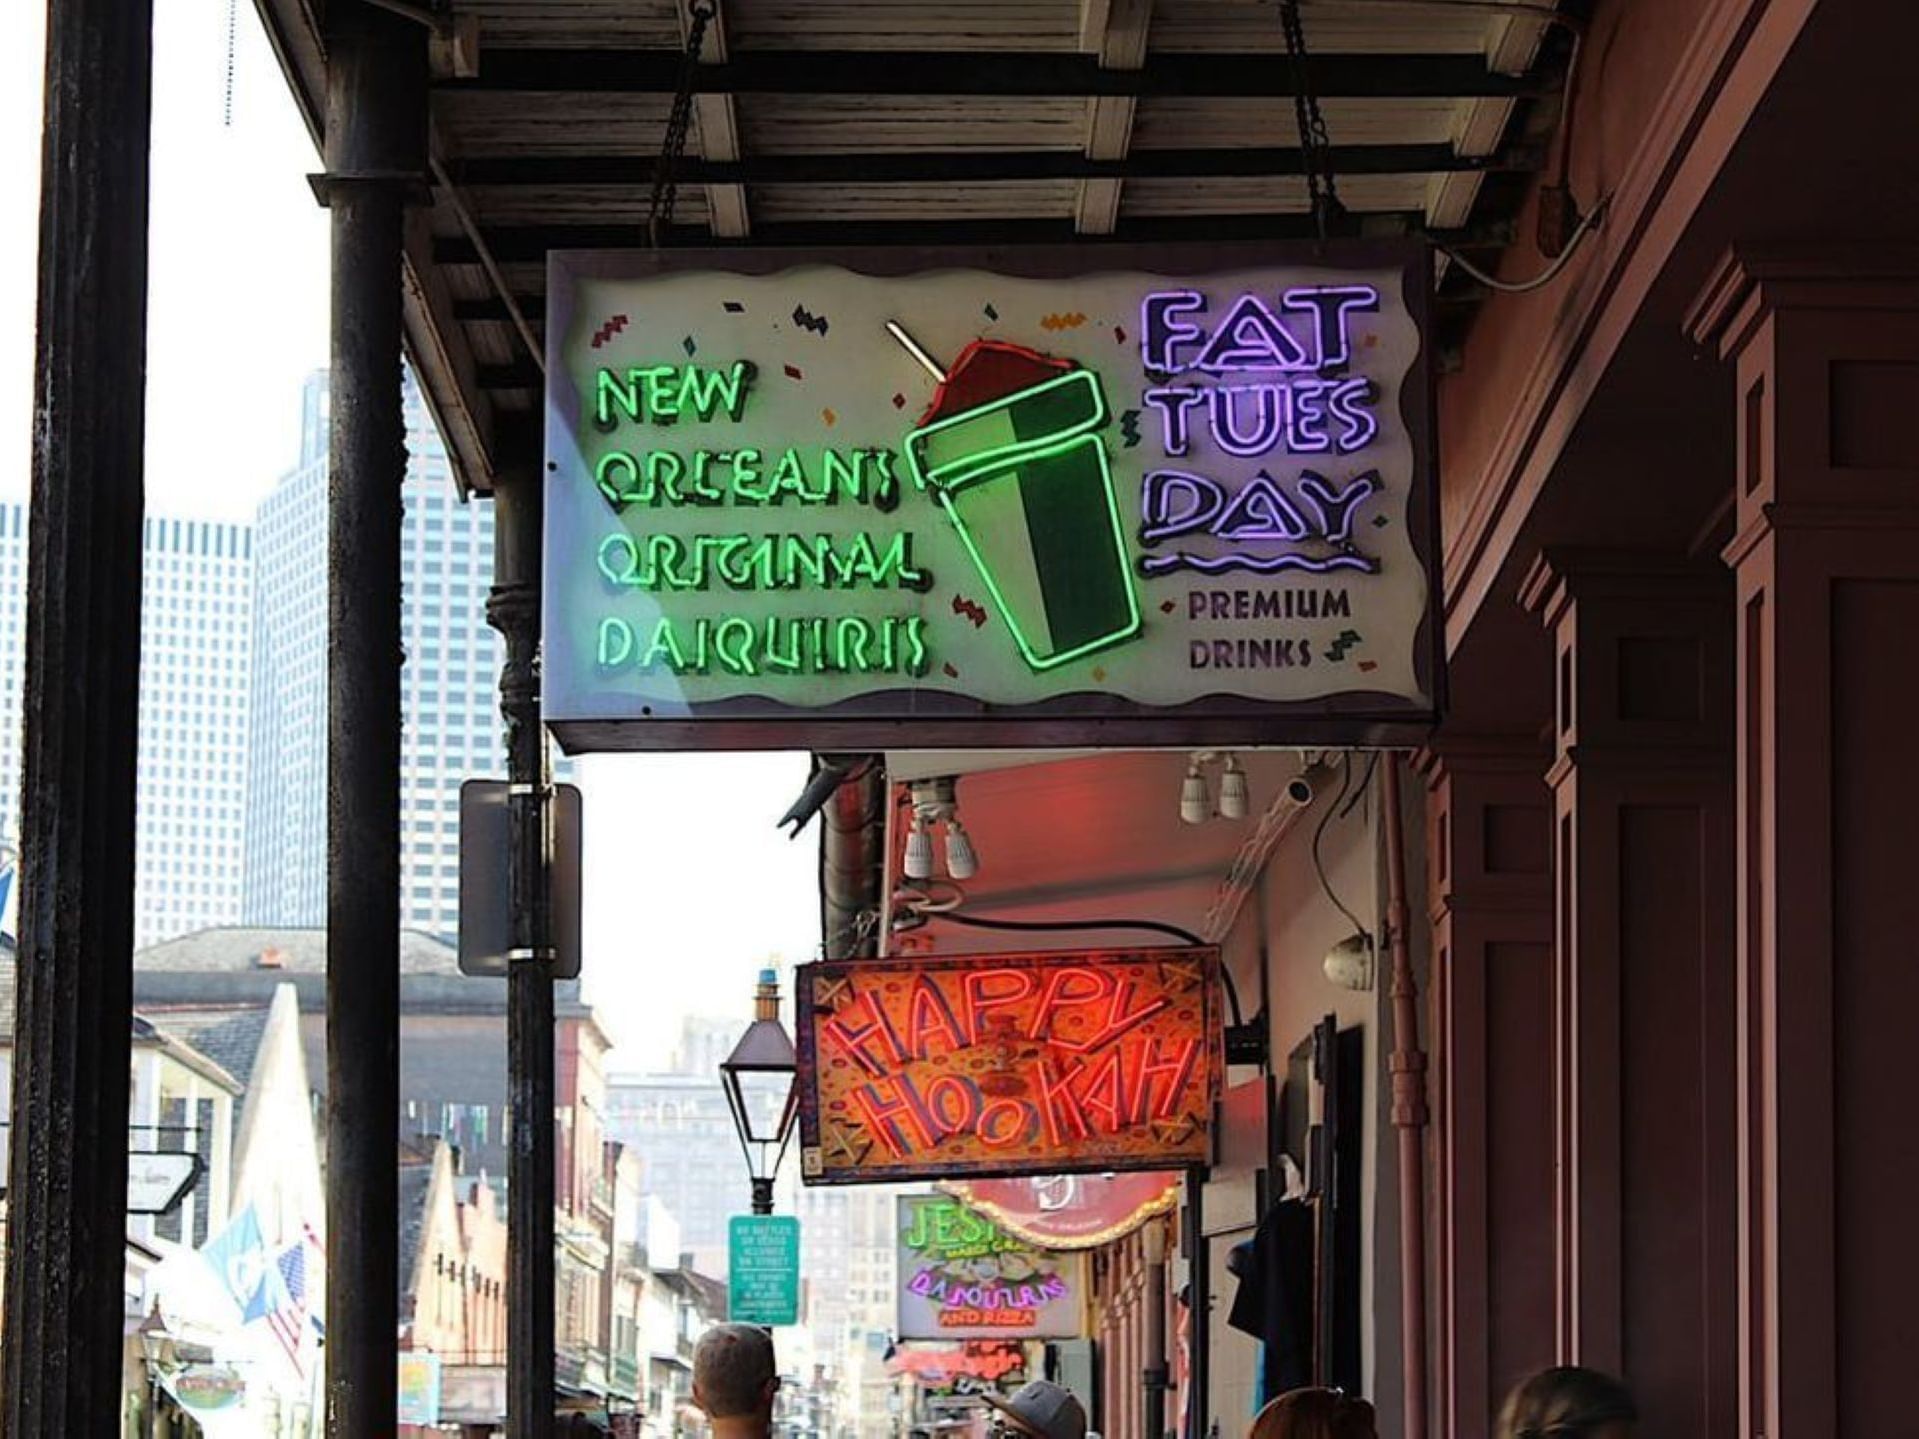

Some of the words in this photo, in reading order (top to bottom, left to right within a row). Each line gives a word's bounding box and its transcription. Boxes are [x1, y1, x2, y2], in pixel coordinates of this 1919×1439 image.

[1142, 287, 1378, 372] FAT
[597, 362, 747, 422] NEW
[1145, 379, 1377, 457] TUES
[597, 452, 897, 503] ORLEANS
[1142, 471, 1378, 543] DAY
[597, 532, 921, 585] ORIGINAL
[1188, 589, 1350, 619] PREMIUM
[598, 617, 924, 673] DAIQUIRIS
[1190, 639, 1311, 669] DRINKS
[826, 967, 1169, 1077] HAPPY
[855, 1039, 1194, 1159] HOOKAH
